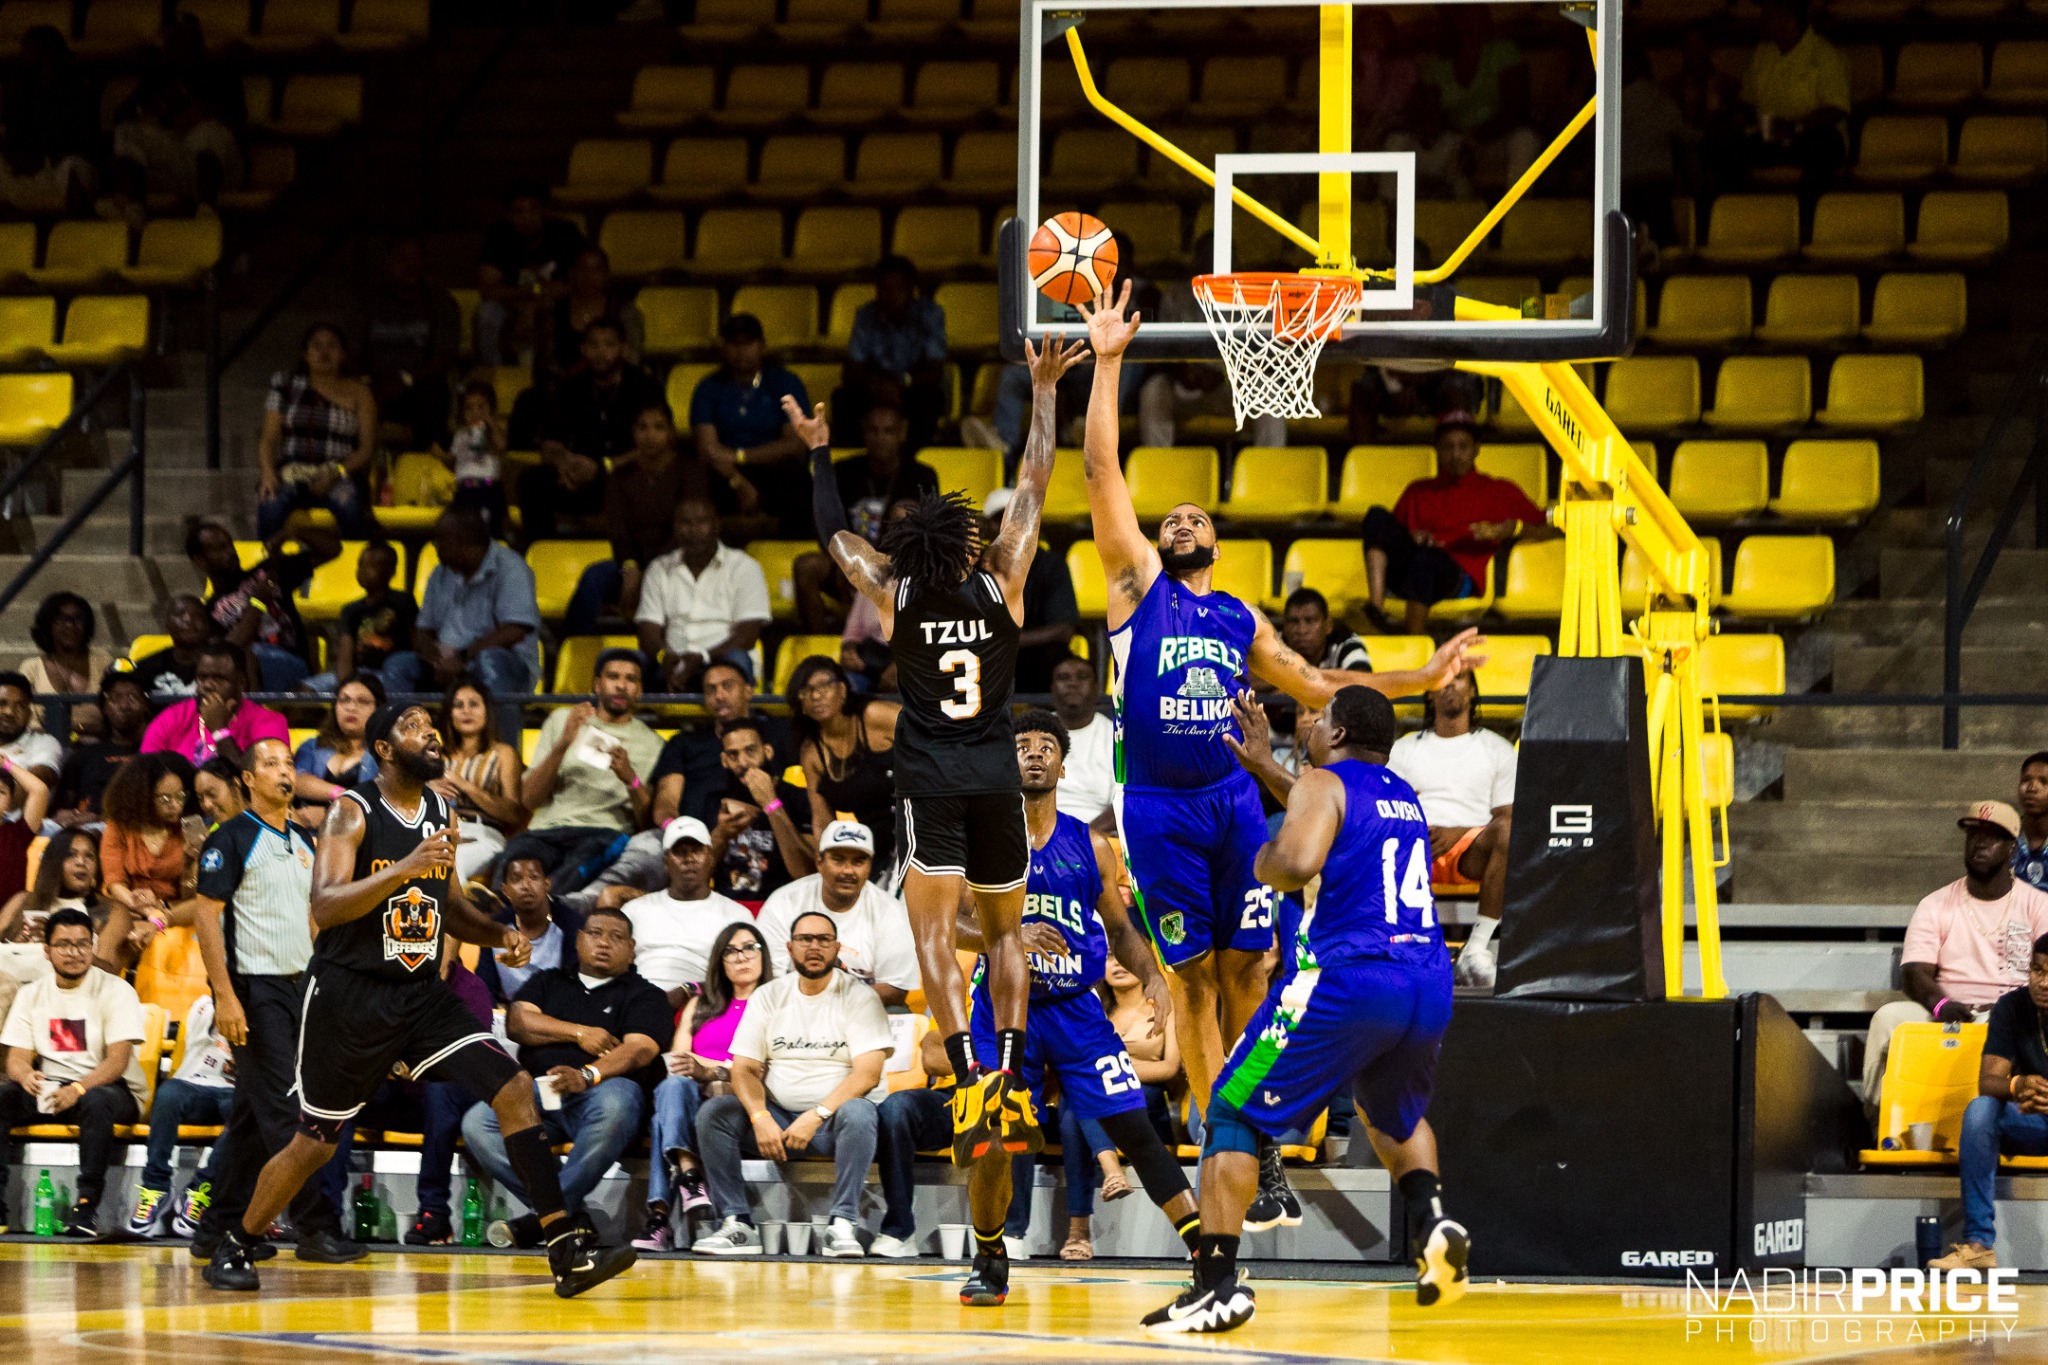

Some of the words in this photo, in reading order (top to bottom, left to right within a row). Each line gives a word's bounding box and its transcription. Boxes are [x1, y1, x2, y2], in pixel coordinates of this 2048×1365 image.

[920, 619, 994, 645] TZUL
[938, 648, 982, 720] 3
[1382, 837, 1435, 928] 14
[1021, 893, 1086, 936] BELS
[1240, 885, 1273, 929] 25
[386, 937, 437, 958] DEFENDERS
[1095, 1050, 1141, 1096] 29
[1621, 1250, 1715, 1267] GARED
[1754, 1218, 1804, 1257] GARED
